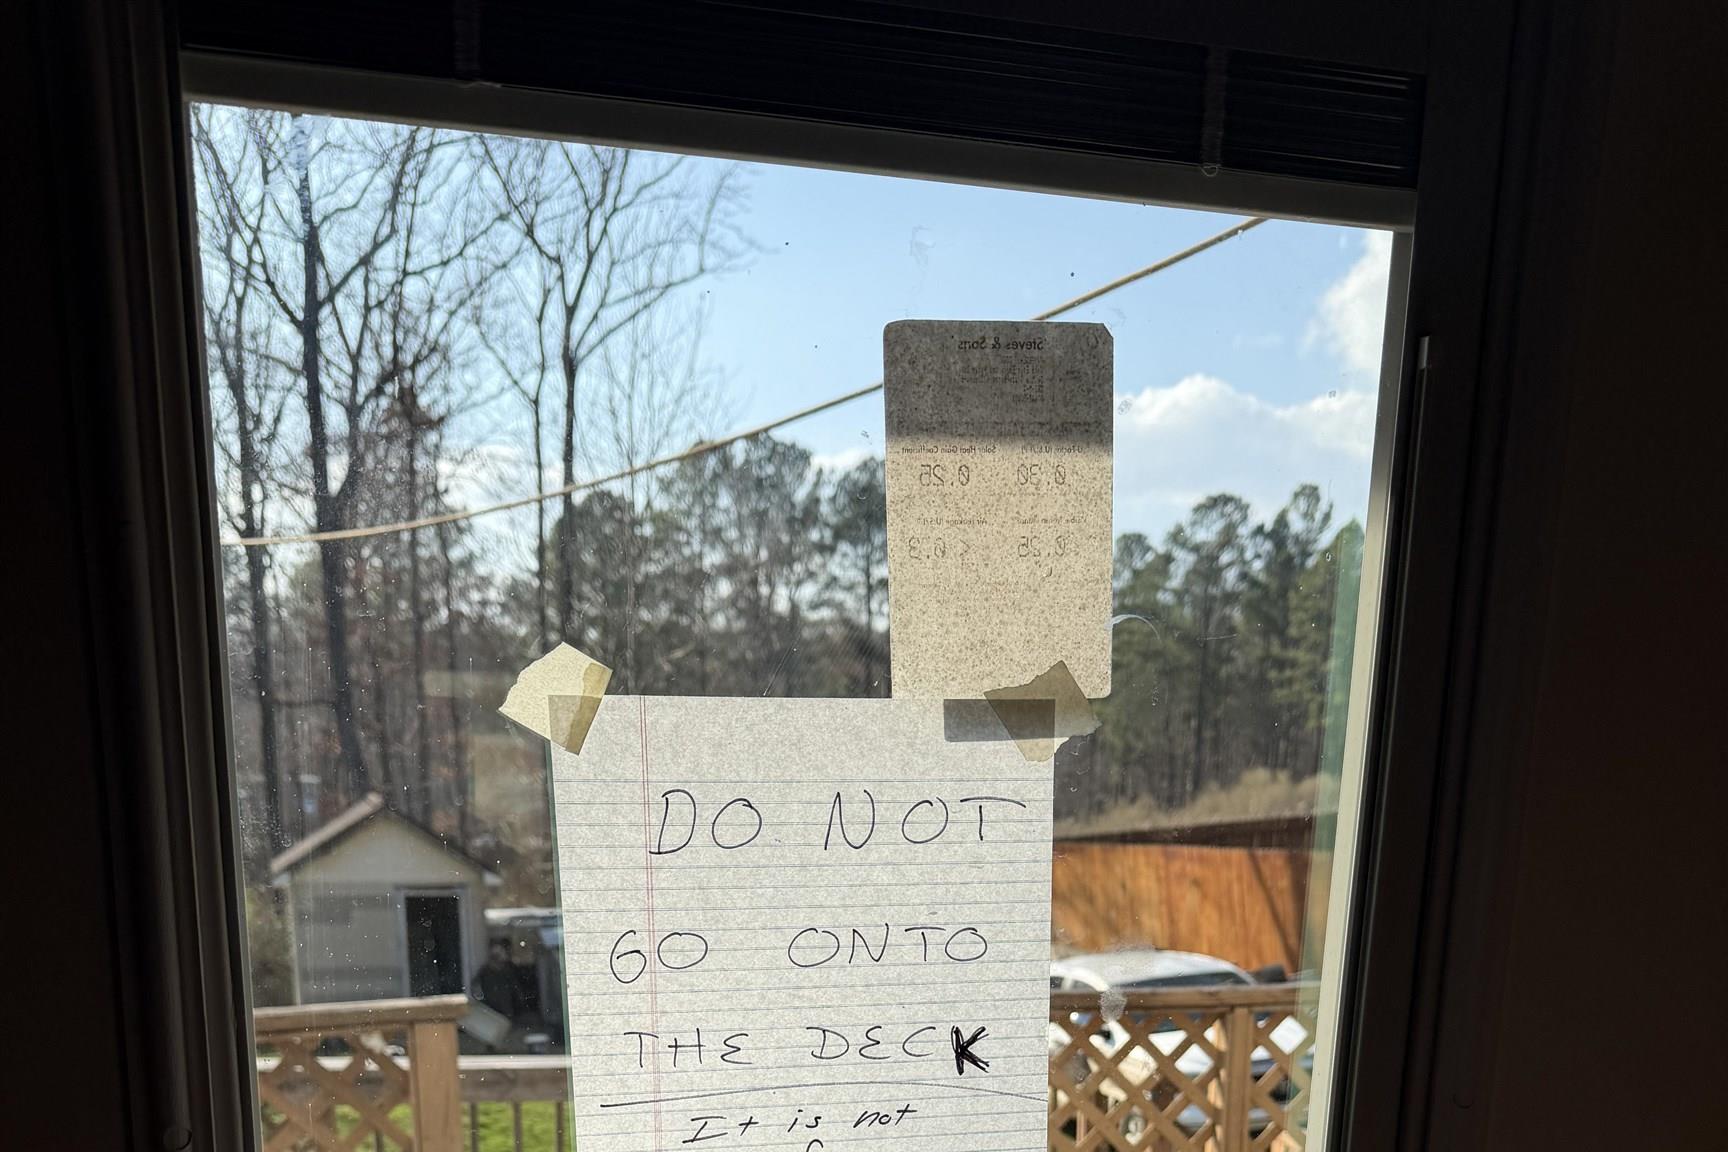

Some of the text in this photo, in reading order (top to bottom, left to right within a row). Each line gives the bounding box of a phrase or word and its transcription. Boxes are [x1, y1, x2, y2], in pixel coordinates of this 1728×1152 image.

[649, 789, 1026, 854] DO NOT
[610, 923, 987, 983] GO ONTO
[624, 1026, 989, 1075] THE DECK
[683, 1104, 917, 1143] It is not
